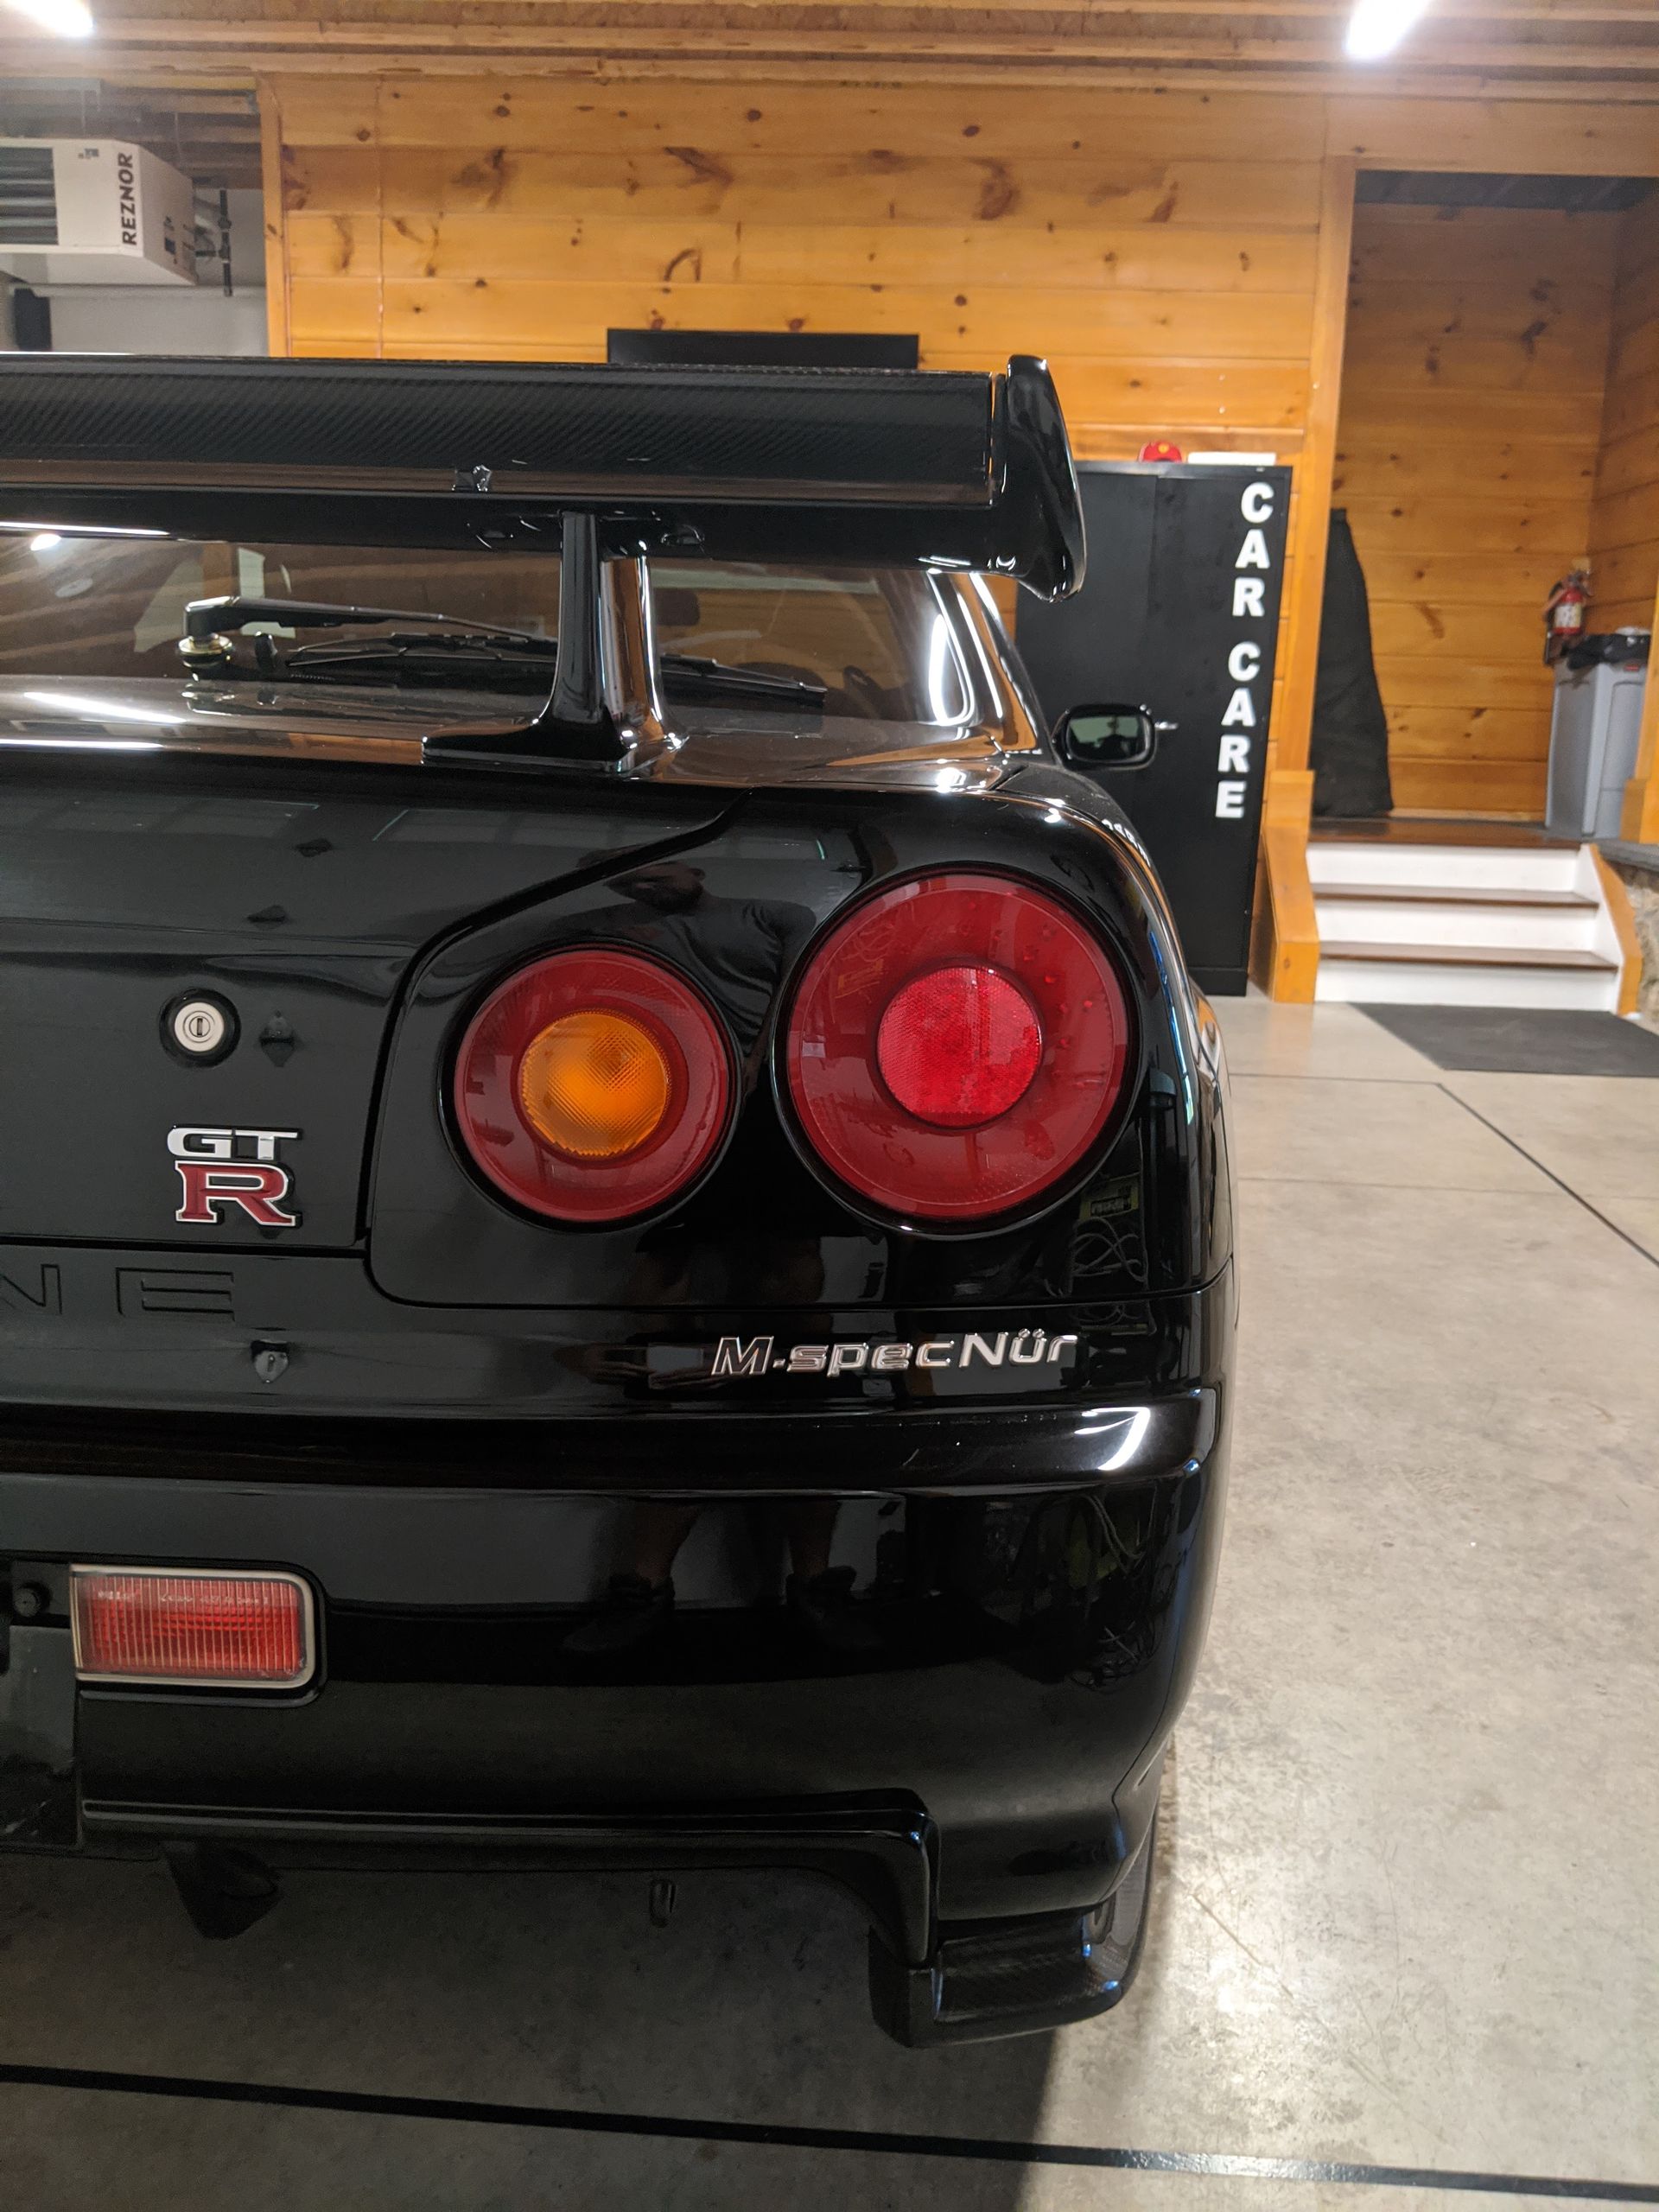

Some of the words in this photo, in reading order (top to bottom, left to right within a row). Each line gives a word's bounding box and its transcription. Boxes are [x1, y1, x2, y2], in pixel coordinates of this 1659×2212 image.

[118, 152, 137, 245] REZNOR
[1232, 481, 1274, 617] CAR
[1216, 641, 1261, 818] CARE
[167, 1127, 300, 1160] GT
[175, 1160, 298, 1227] R
